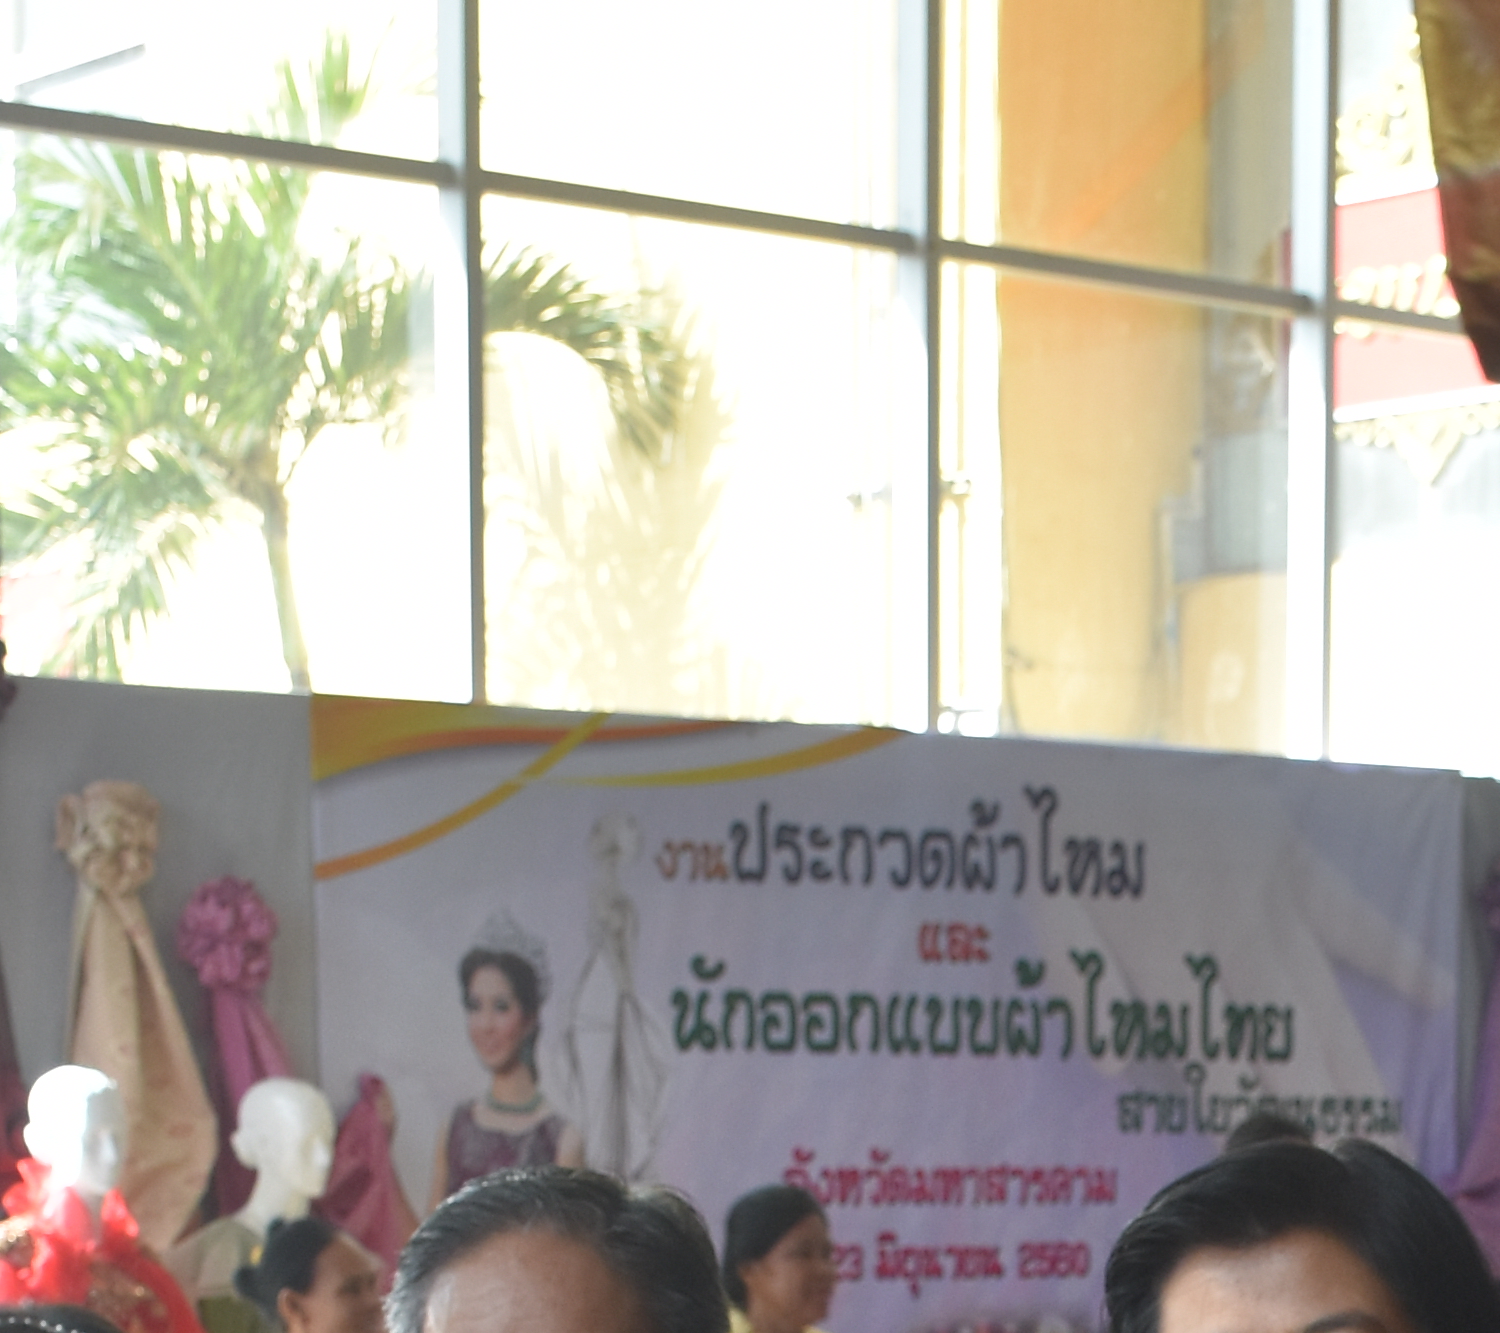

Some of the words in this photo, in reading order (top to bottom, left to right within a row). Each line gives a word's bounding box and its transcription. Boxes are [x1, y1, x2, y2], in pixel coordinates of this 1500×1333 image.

[916, 919, 992, 964] และ
[669, 948, 1296, 1062] นักออกแบบผ้าไหมไทย
